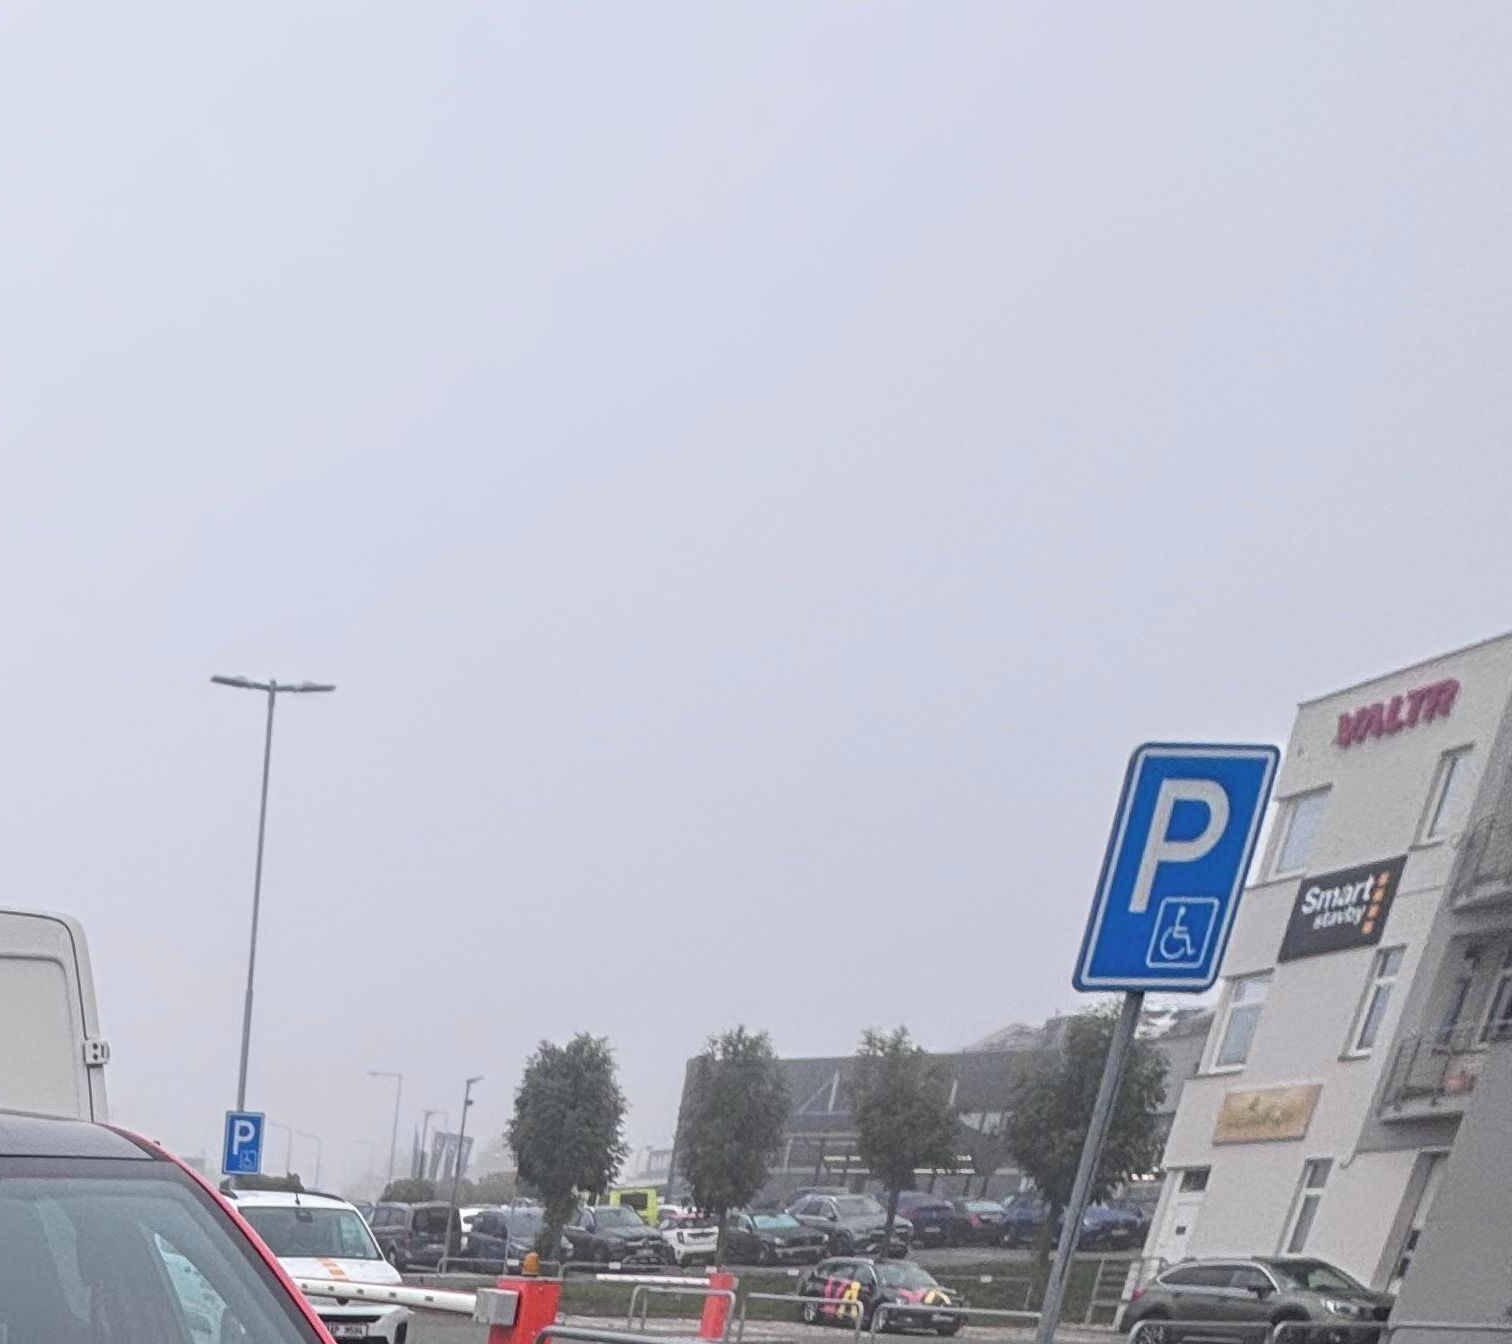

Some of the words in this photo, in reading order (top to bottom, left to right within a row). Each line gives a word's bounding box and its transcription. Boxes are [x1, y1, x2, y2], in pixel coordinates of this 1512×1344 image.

[1128, 777, 1230, 913] P
[1301, 873, 1375, 915] Smart
[232, 1119, 256, 1156] P
